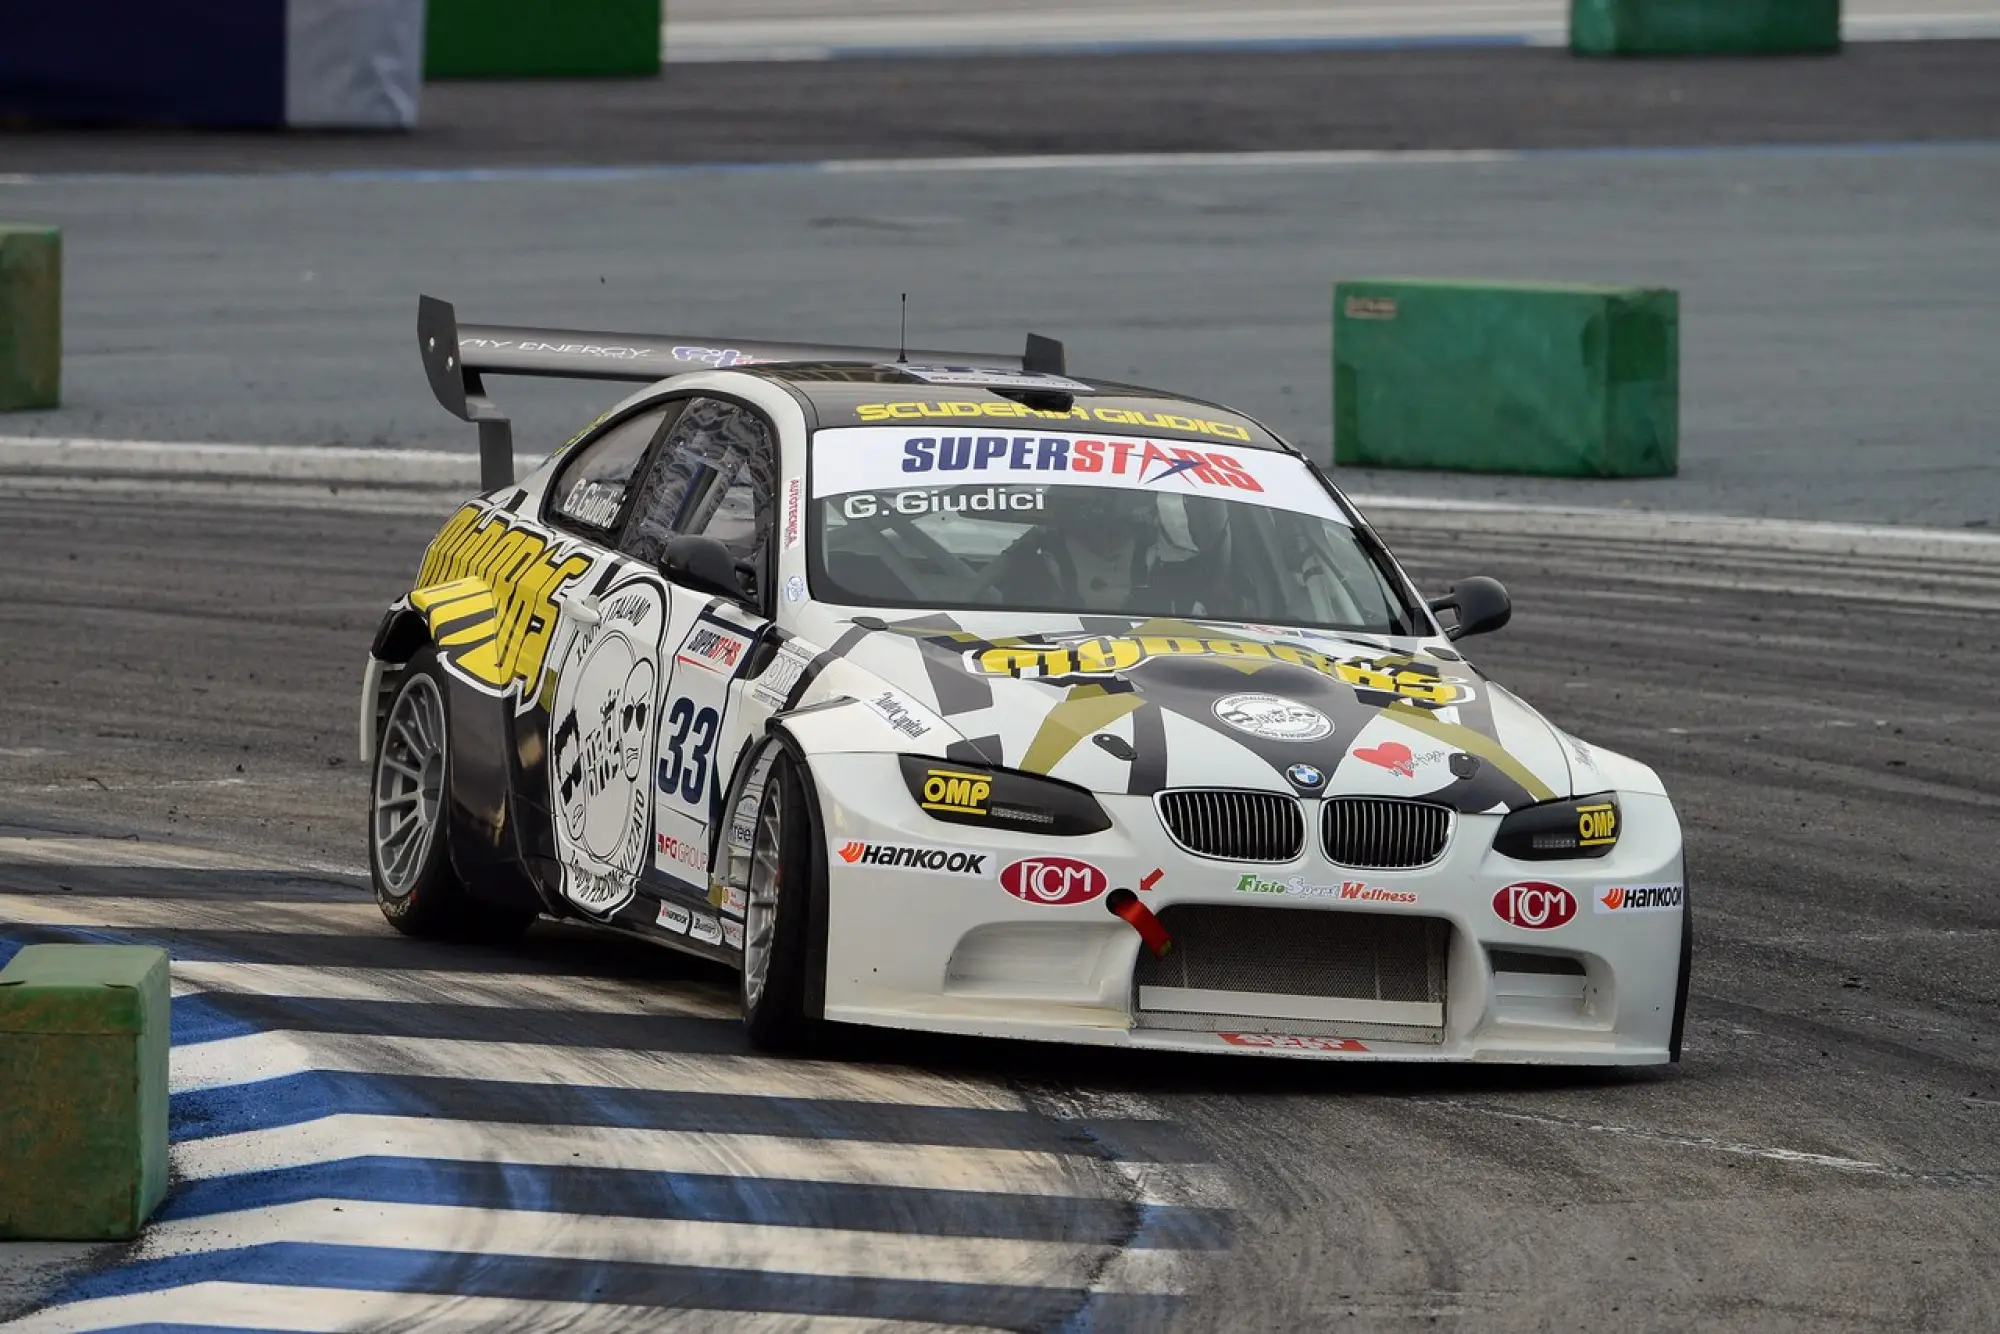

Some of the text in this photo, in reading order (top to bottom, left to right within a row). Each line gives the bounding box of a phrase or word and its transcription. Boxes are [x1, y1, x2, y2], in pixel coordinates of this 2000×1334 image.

[1093, 408, 1250, 441] GIUDICI
[901, 436, 1264, 493] SUPERSTARS
[844, 488, 1045, 518] G.Giudici
[657, 696, 720, 805] 33
[924, 777, 990, 807] OMP
[1579, 810, 1616, 838] OMP
